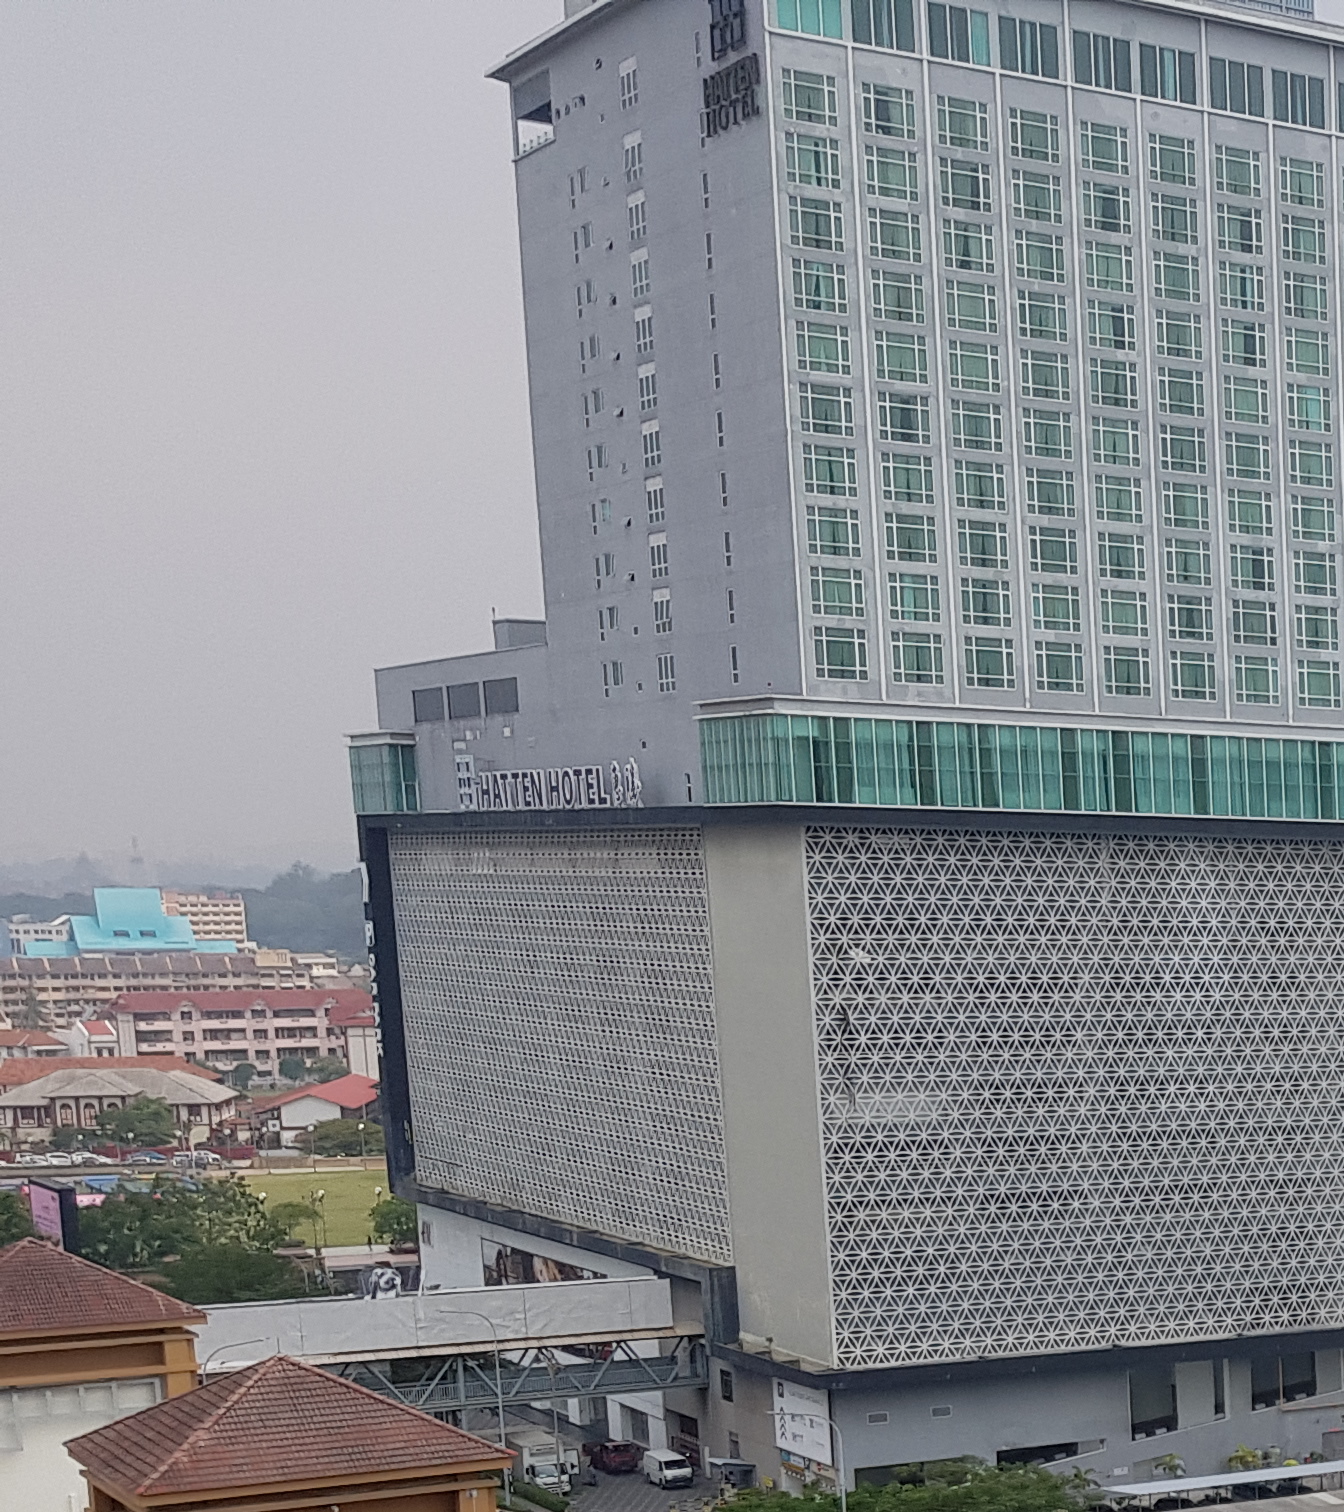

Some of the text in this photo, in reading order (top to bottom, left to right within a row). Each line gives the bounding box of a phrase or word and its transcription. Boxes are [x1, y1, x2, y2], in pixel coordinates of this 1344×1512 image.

[705, 89, 760, 138] HOTEL
[478, 768, 544, 810] HATTEN
[547, 765, 610, 808] HOTEL
